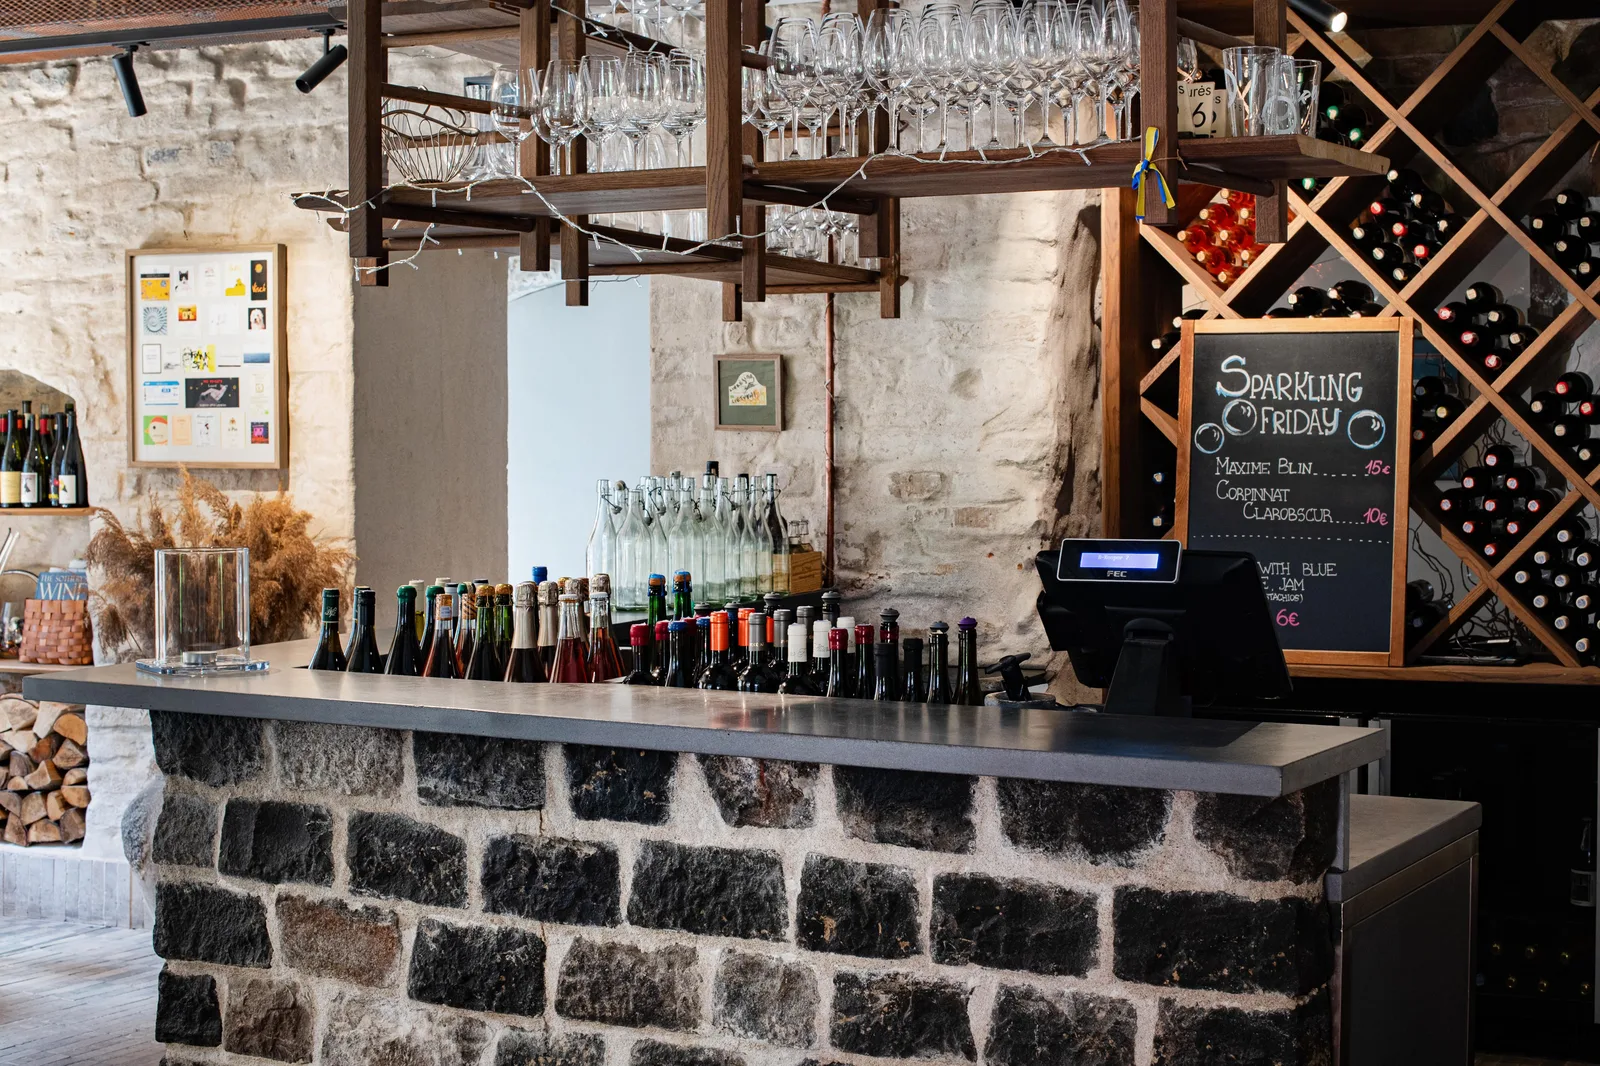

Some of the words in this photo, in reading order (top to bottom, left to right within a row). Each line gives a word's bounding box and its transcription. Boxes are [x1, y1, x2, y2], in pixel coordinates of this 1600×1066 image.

[1215, 354, 1363, 403] SPARKLING
[1260, 406, 1342, 436] FRIDAY
[1215, 456, 1270, 475] MAXIME
[1364, 459, 1391, 475] 15€
[1216, 479, 1290, 502] CORPINNAT
[1363, 507, 1389, 526] 10€
[1106, 570, 1128, 578] FEC
[1257, 561, 1291, 576] WITH
[1302, 562, 1337, 577] BLUE
[1278, 577, 1305, 592] JAM
[1275, 608, 1300, 627] 6€
